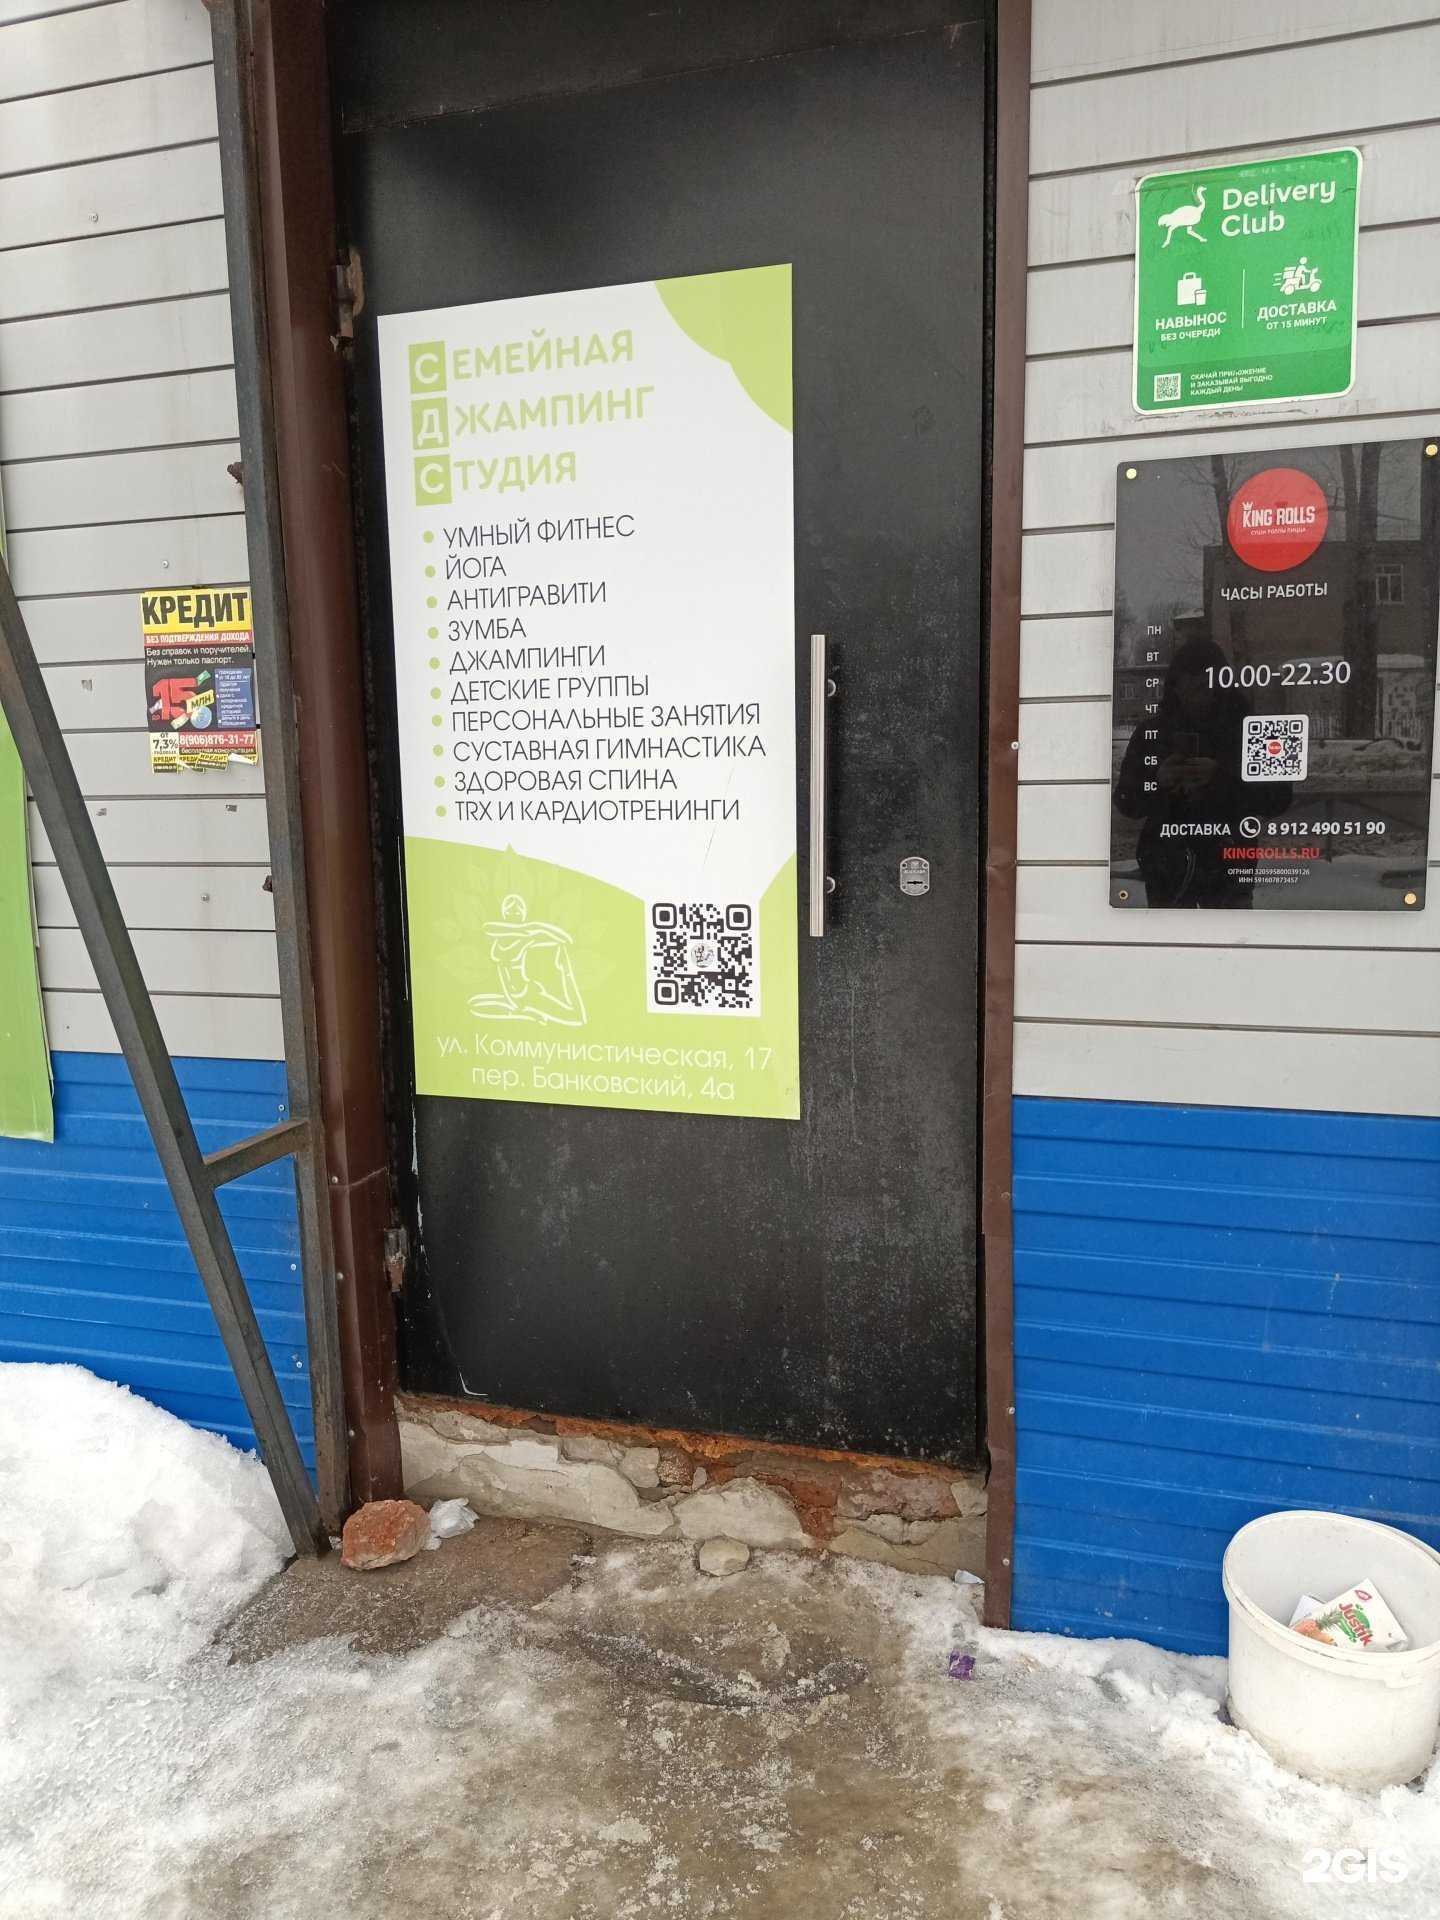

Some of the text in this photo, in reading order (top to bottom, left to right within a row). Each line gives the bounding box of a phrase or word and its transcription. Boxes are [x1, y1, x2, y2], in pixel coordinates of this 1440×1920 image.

[1223, 180, 1336, 210] Delivery
[1221, 210, 1285, 237] Club
[1155, 311, 1227, 330] НАВЫНОС
[1256, 300, 1337, 321] ДОСТАВКА
[1266, 317, 1328, 330] ОТ 15 МИНУТ
[1160, 328, 1221, 342] БЕЗ ОЧЕРЕДИ
[414, 328, 634, 385] СЕМЕЙНАЯ
[416, 386, 655, 446] ДЖАМПИНГ
[419, 451, 577, 494] СТУДИЯ
[1242, 505, 1317, 528] KING ROLLS
[443, 514, 635, 549] УМНЫЙ ФИТНЕС
[446, 553, 507, 580] ЙОГА
[448, 581, 607, 611] АНТИГРАВИТИ
[1220, 582, 1328, 601] ЧАСЫ РАБОТЫ
[142, 592, 249, 629] КРЕДИТ
[220, 631, 250, 642] ДОХОДА
[448, 617, 527, 642] ЗУМБА
[1147, 625, 1162, 635] ПН
[146, 648, 161, 656] Без
[161, 648, 192, 657] справок
[147, 658, 172, 668] Нужен
[450, 645, 605, 675] ДЖАМПИНГИ
[1146, 651, 1160, 662] ВТ
[1145, 678, 1160, 688] СР
[1205, 661, 1351, 689] 10.00-22.30
[451, 675, 649, 705] ДЕТСКИЕ ГРУППЫ
[190, 694, 212, 709] МЛН
[1145, 703, 1159, 713] ЧТ
[452, 703, 760, 732] ПЕРСОНАЛЬНЫЕ ЗАНЯТИЯ
[153, 739, 179, 750] 7,3%
[180, 733, 254, 747] 8(906)876-31-77
[1144, 729, 1158, 740] ПТ
[453, 736, 767, 762] СУСТАВНАЯ ГИМНАСТИКА
[1144, 755, 1158, 766] СБ
[454, 768, 678, 794] ЗДОРОВАЯ СПИНА
[1143, 781, 1158, 792] ВС
[455, 800, 740, 824] TRX И КАРДИОТРЕНИНГИ
[1160, 822, 1386, 838] ДОСТАВКА 8 912 490 51 90
[1223, 847, 1320, 860] KINGROLLS.RU
[437, 1034, 773, 1071] ул. Коммунистическая, 17
[472, 1066, 735, 1101] пер. Банковский, 4а
